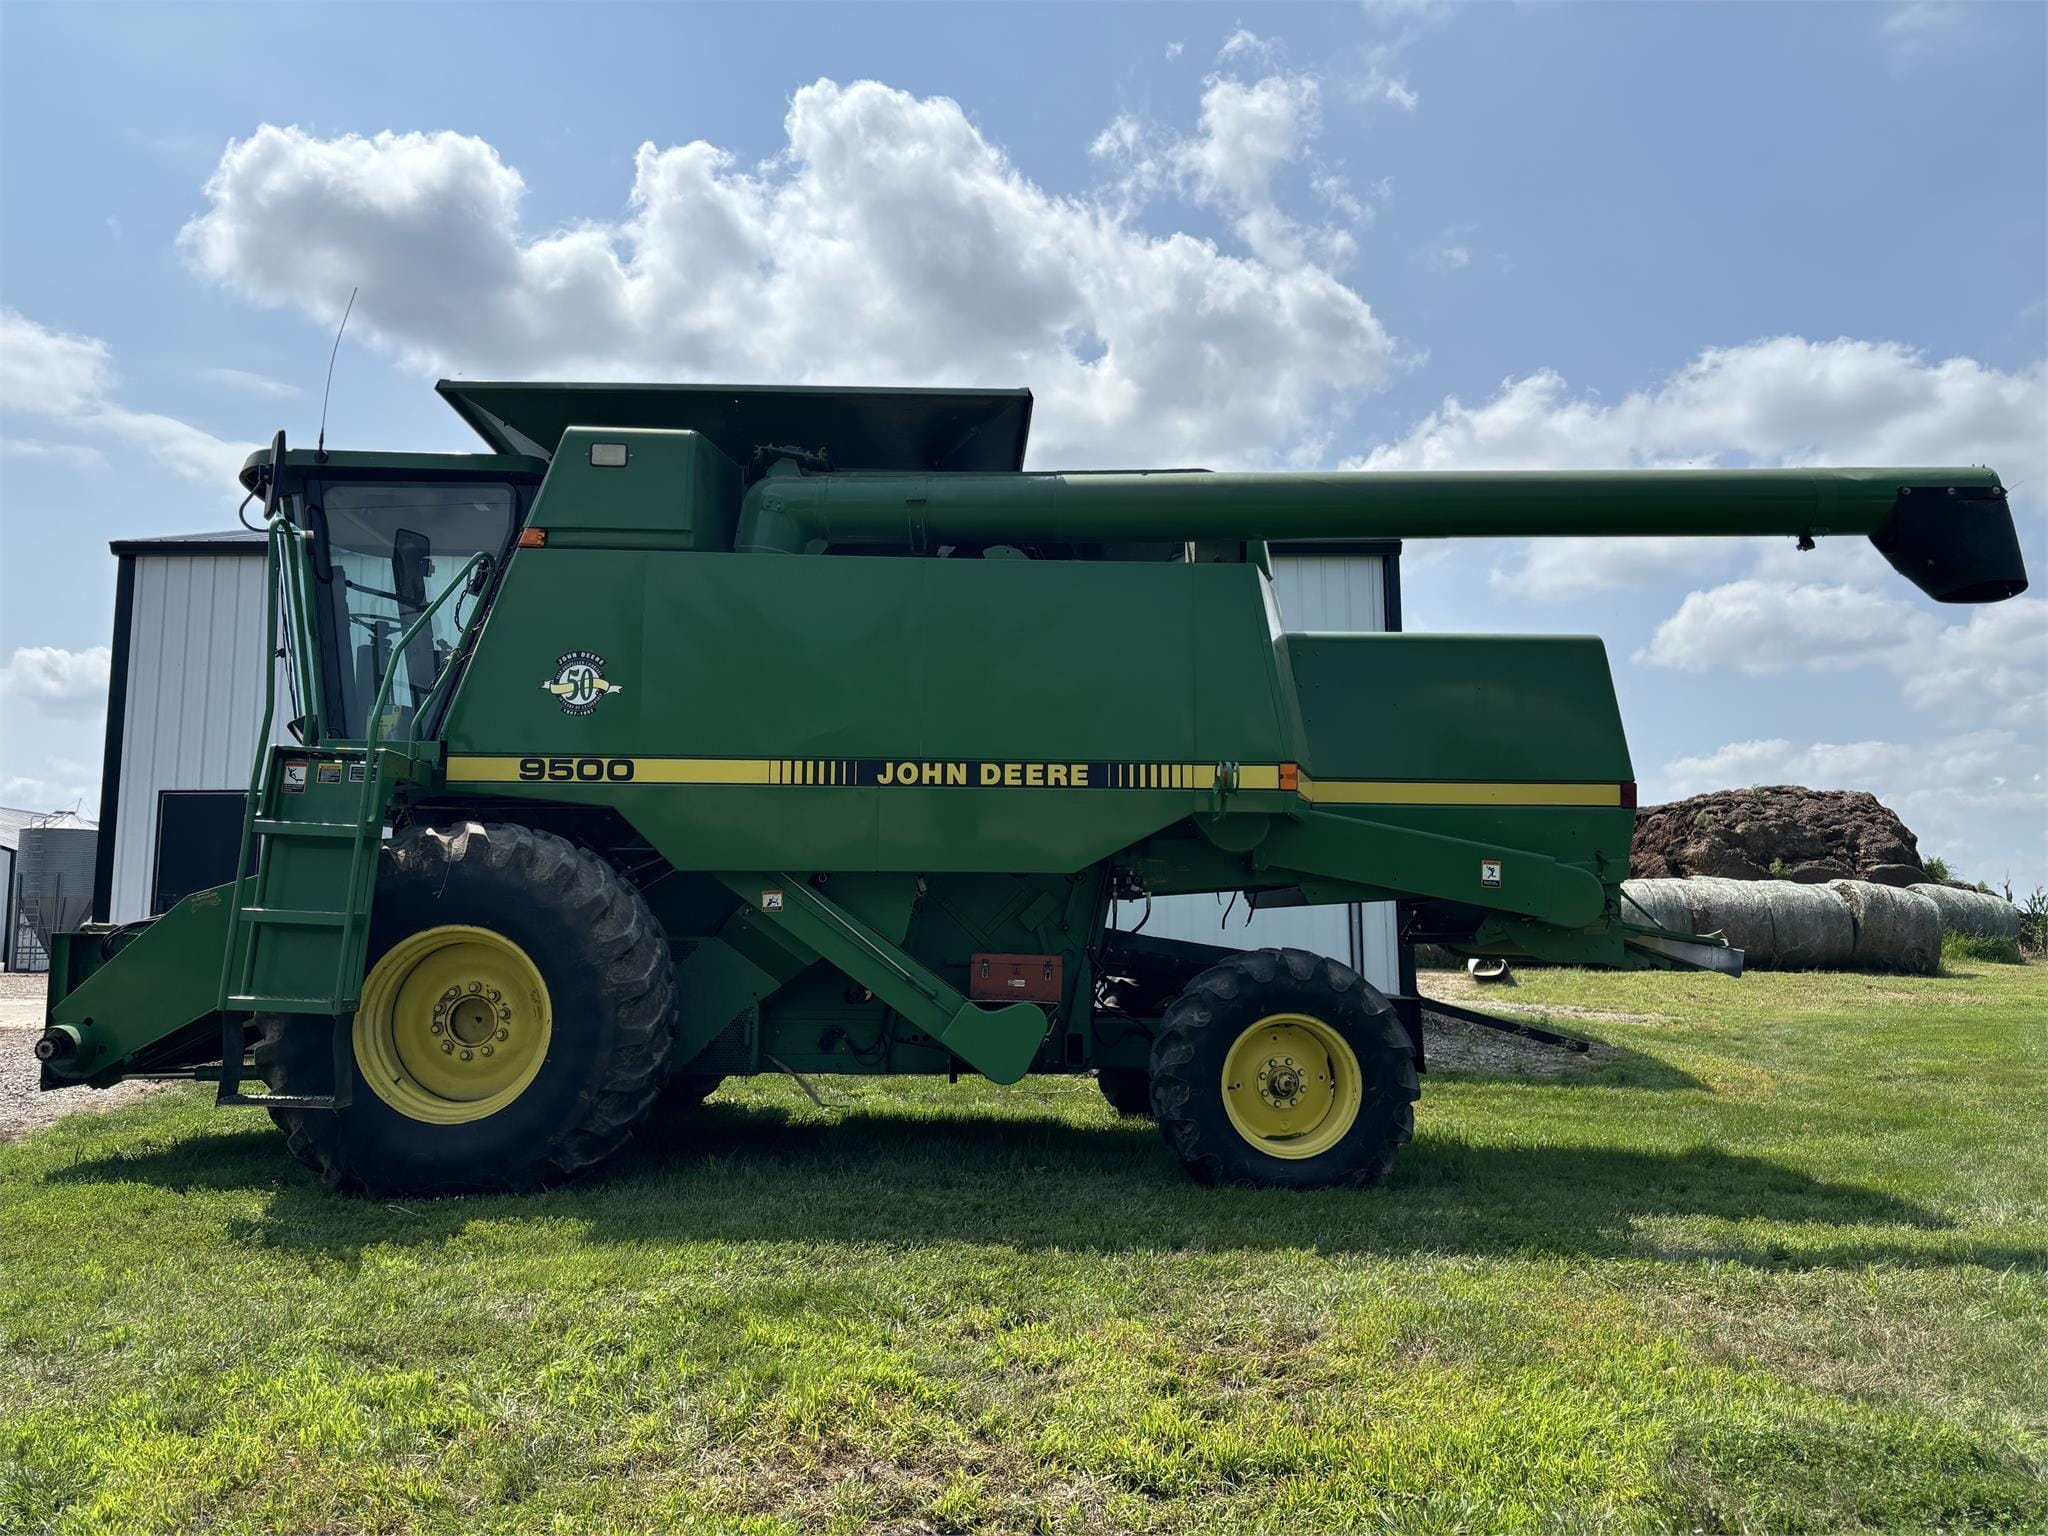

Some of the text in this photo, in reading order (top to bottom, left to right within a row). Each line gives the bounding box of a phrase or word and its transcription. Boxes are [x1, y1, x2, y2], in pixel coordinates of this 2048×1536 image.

[558, 652, 604, 666] JOHN DEERE
[565, 668, 594, 701] 50
[519, 758, 635, 781] 9500
[876, 762, 1089, 786] JOHN DEERE
